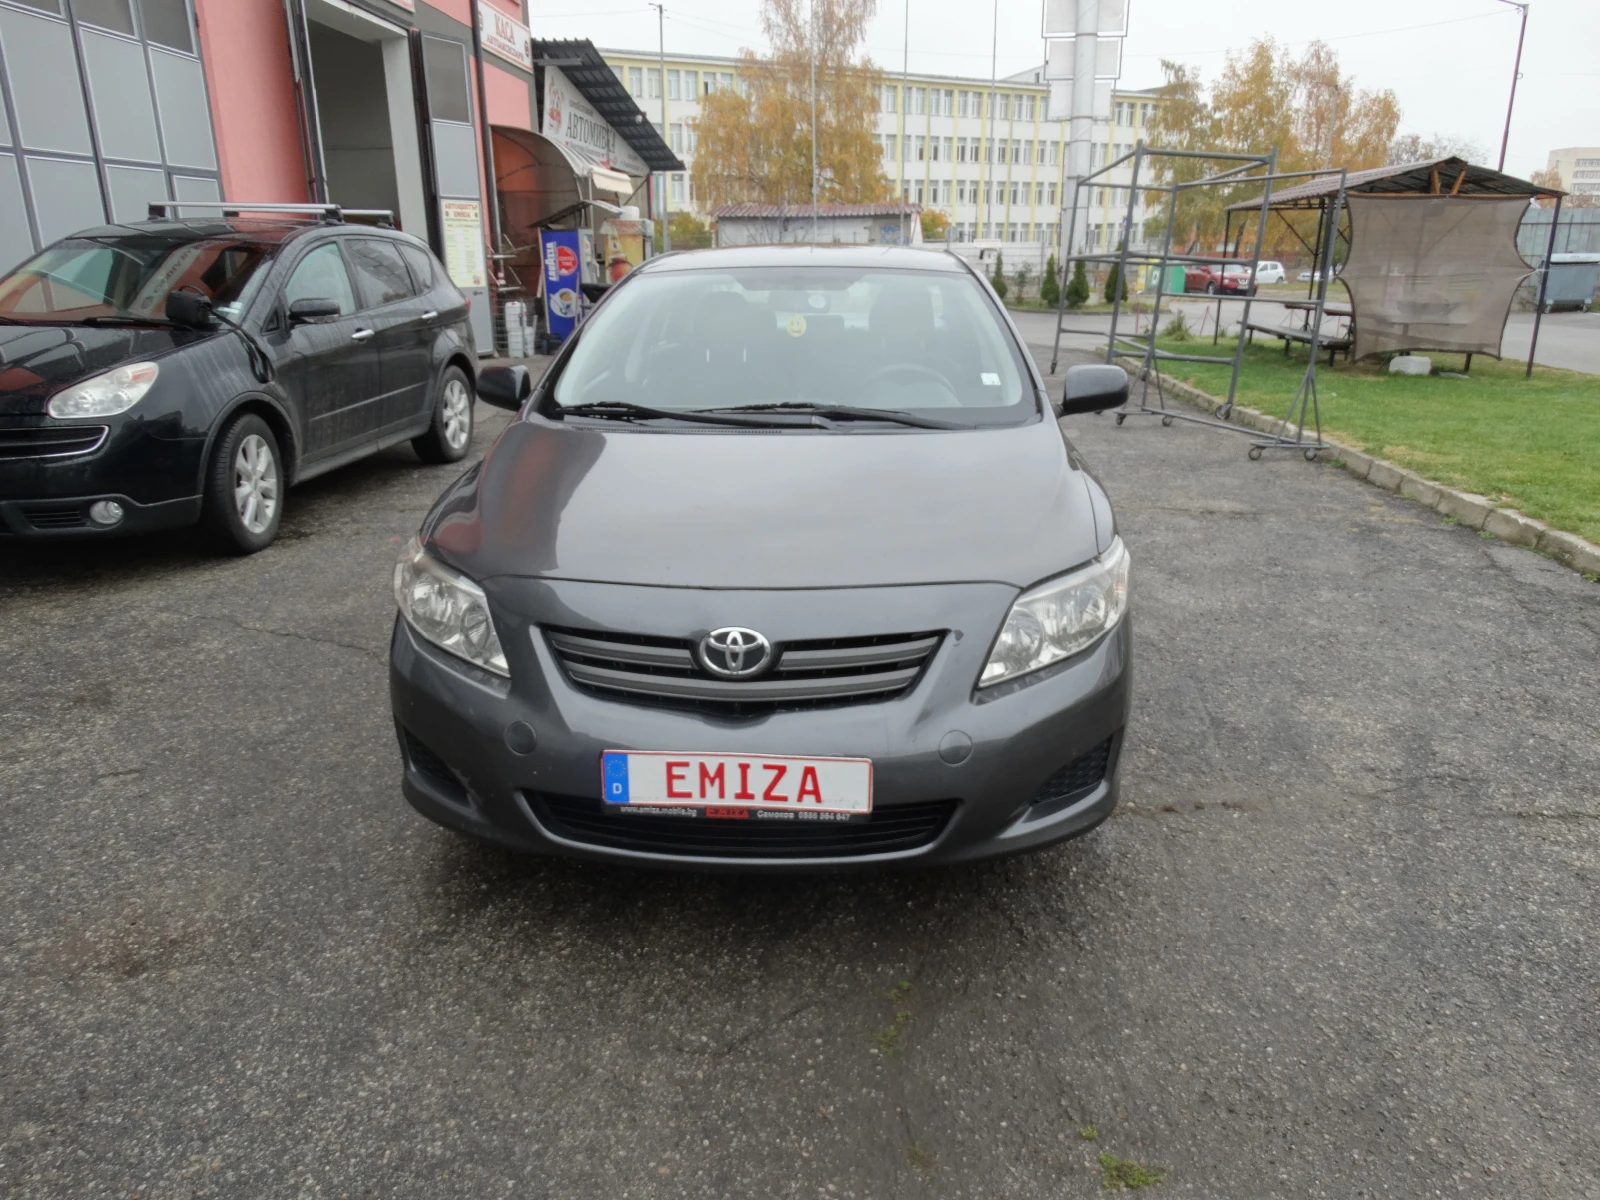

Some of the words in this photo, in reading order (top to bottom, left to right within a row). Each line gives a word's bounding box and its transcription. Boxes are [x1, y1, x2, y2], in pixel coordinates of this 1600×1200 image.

[494, 13, 516, 46] КАСА
[612, 782, 622, 794] D
[665, 761, 823, 804] EMIZA
